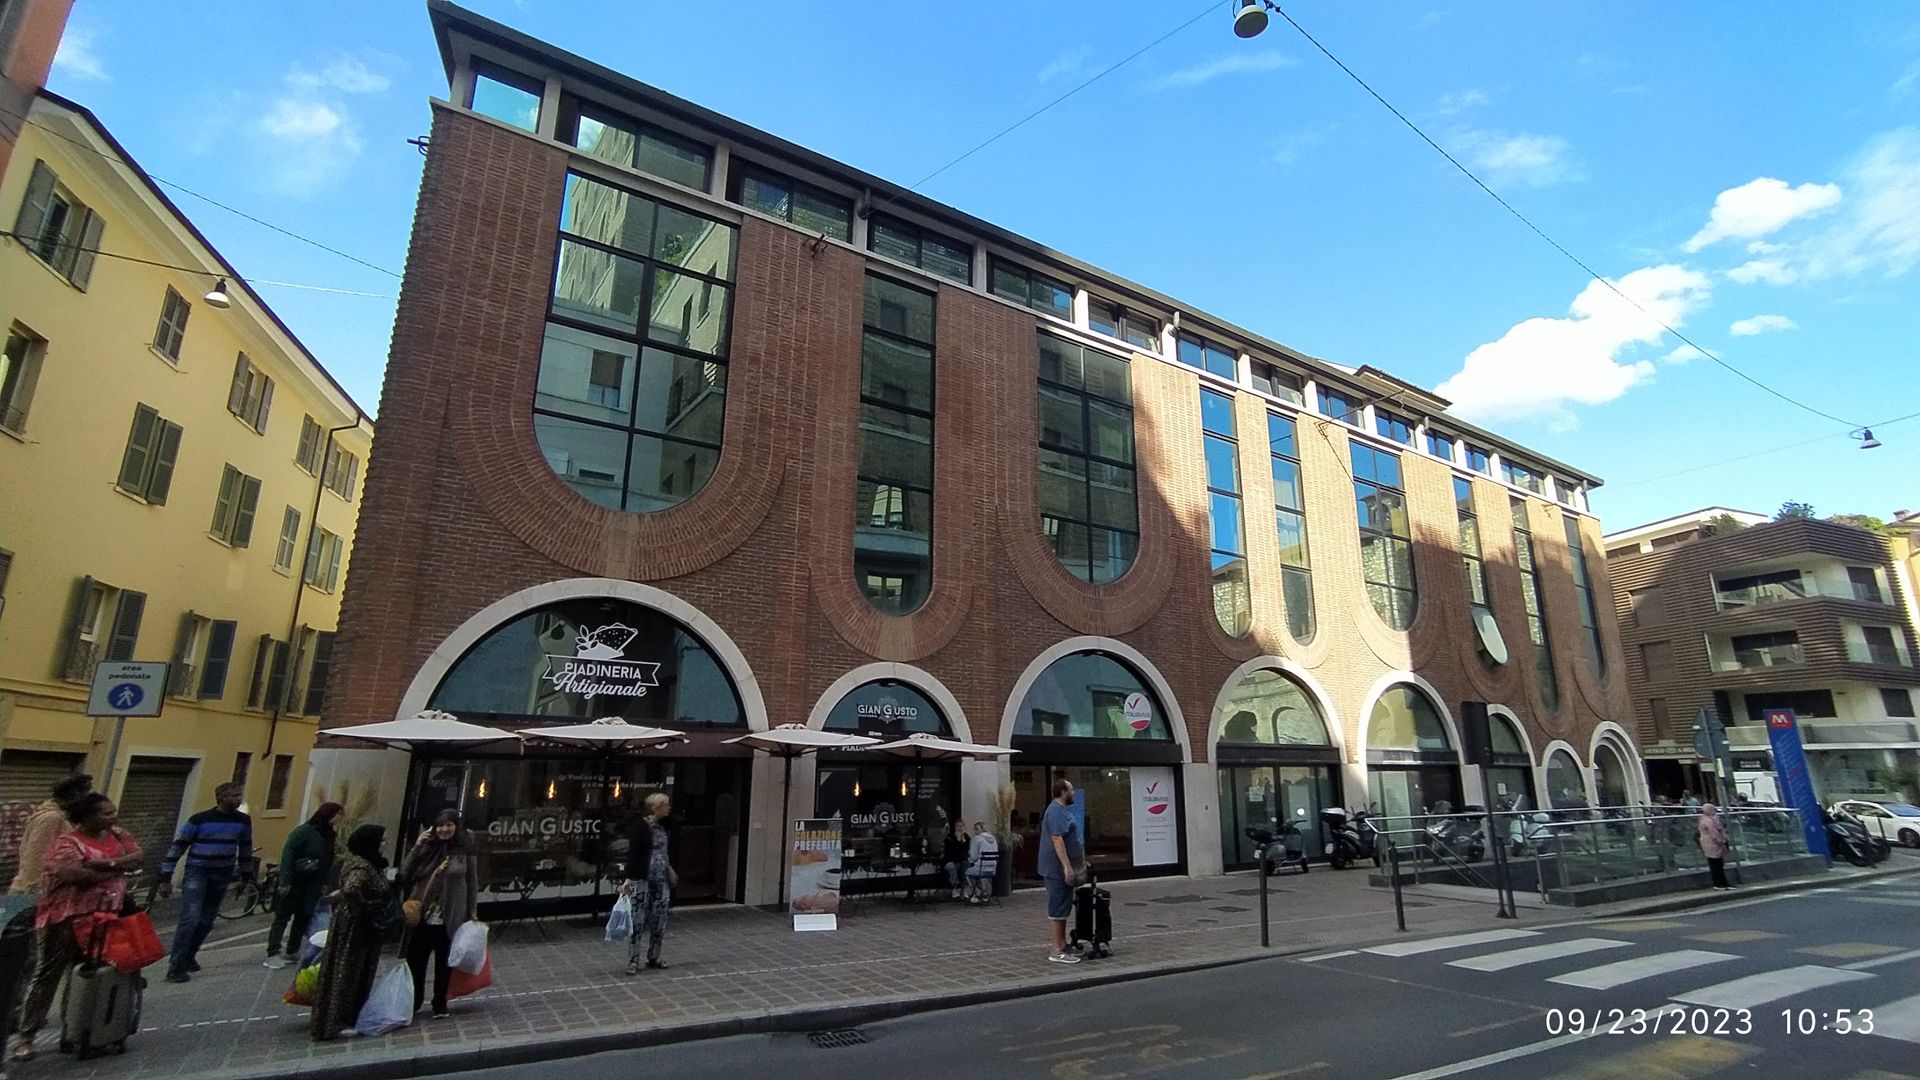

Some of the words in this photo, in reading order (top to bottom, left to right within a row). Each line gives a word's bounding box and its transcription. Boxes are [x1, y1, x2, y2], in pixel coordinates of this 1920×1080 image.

[564, 662, 642, 680] PIADINERIA
[108, 673, 151, 681] pedonale
[552, 671, 647, 700] Artigianale
[857, 704, 881, 715] GIAN
[850, 813, 877, 824] GIAN
[488, 820, 534, 836] GIAN
[795, 821, 805, 832] LA
[794, 830, 842, 841] COLAZIONE
[794, 840, 842, 851] PREFERITA
